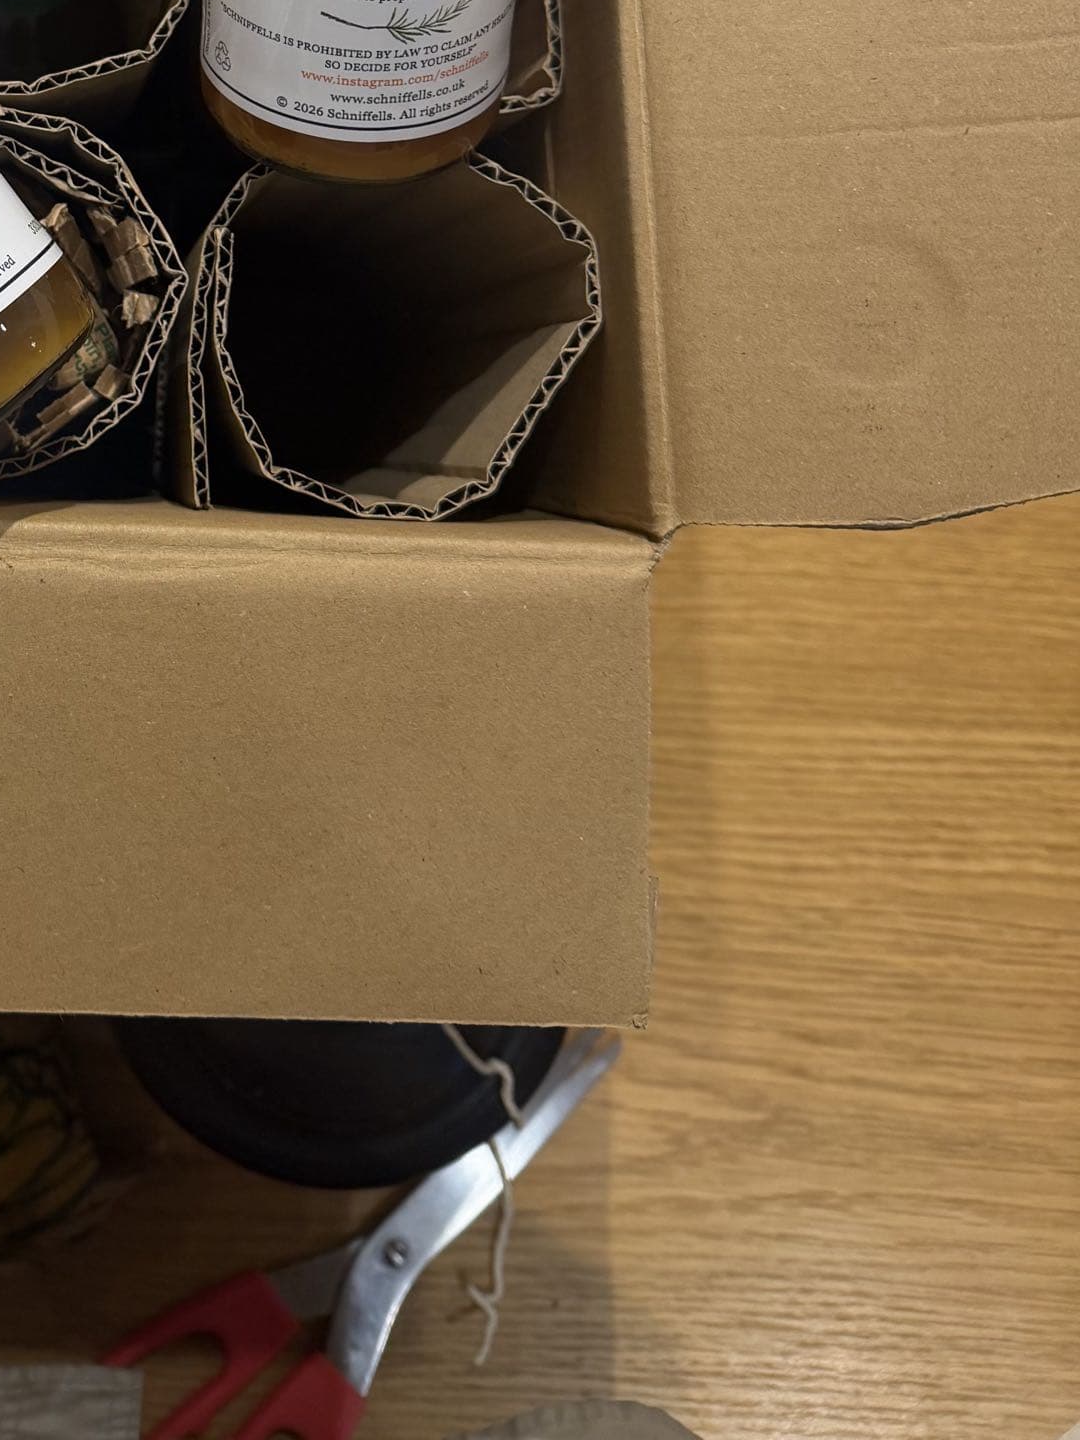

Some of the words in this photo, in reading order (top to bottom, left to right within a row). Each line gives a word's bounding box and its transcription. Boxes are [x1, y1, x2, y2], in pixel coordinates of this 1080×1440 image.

[283, 36, 294, 46] IS
[297, 40, 372, 59] PROHIBITED
[376, 50, 392, 59] BY
[394, 47, 422, 59] LAW
[423, 44, 439, 55] TO
[440, 34, 473, 52] CLAIM
[301, 50, 489, 89] www.instagram.com/schniffells
[324, 60, 341, 70] SO
[344, 62, 391, 72] DECIDE
[394, 61, 418, 72] FOR
[331, 78, 466, 105] www.schniffells.co.uk
[293, 101, 324, 117] 2026
[327, 108, 396, 121] Schniffells.
[399, 108, 417, 120] All
[420, 101, 451, 117] rights
